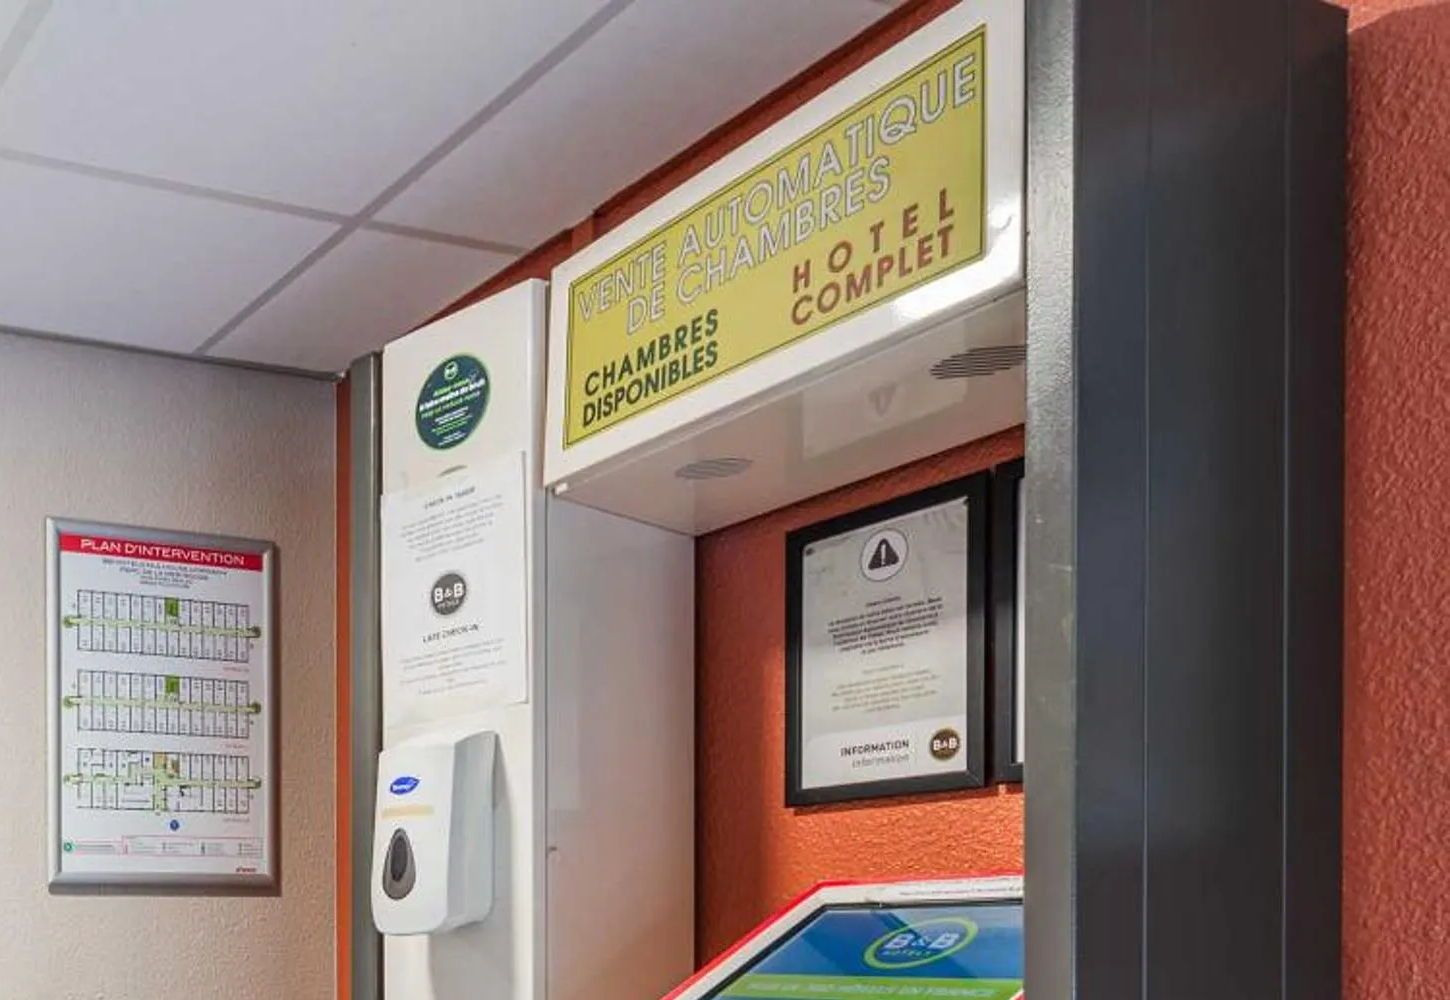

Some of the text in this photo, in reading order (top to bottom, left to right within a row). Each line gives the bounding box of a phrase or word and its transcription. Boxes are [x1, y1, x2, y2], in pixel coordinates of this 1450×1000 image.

[578, 52, 977, 321] VENTE AUTOMATIQUE
[626, 156, 891, 335] DE CHAMBRES
[791, 224, 955, 326] COMPLET
[792, 187, 955, 295] HOTEL
[583, 340, 719, 428] DISPONIBLES
[585, 308, 719, 397] CHAMBRES
[80, 538, 245, 566] PLAN D'INTERVENTION
[434, 583, 464, 604] B&B
[840, 739, 910, 757] INFORMATION
[883, 932, 960, 949] B&B
